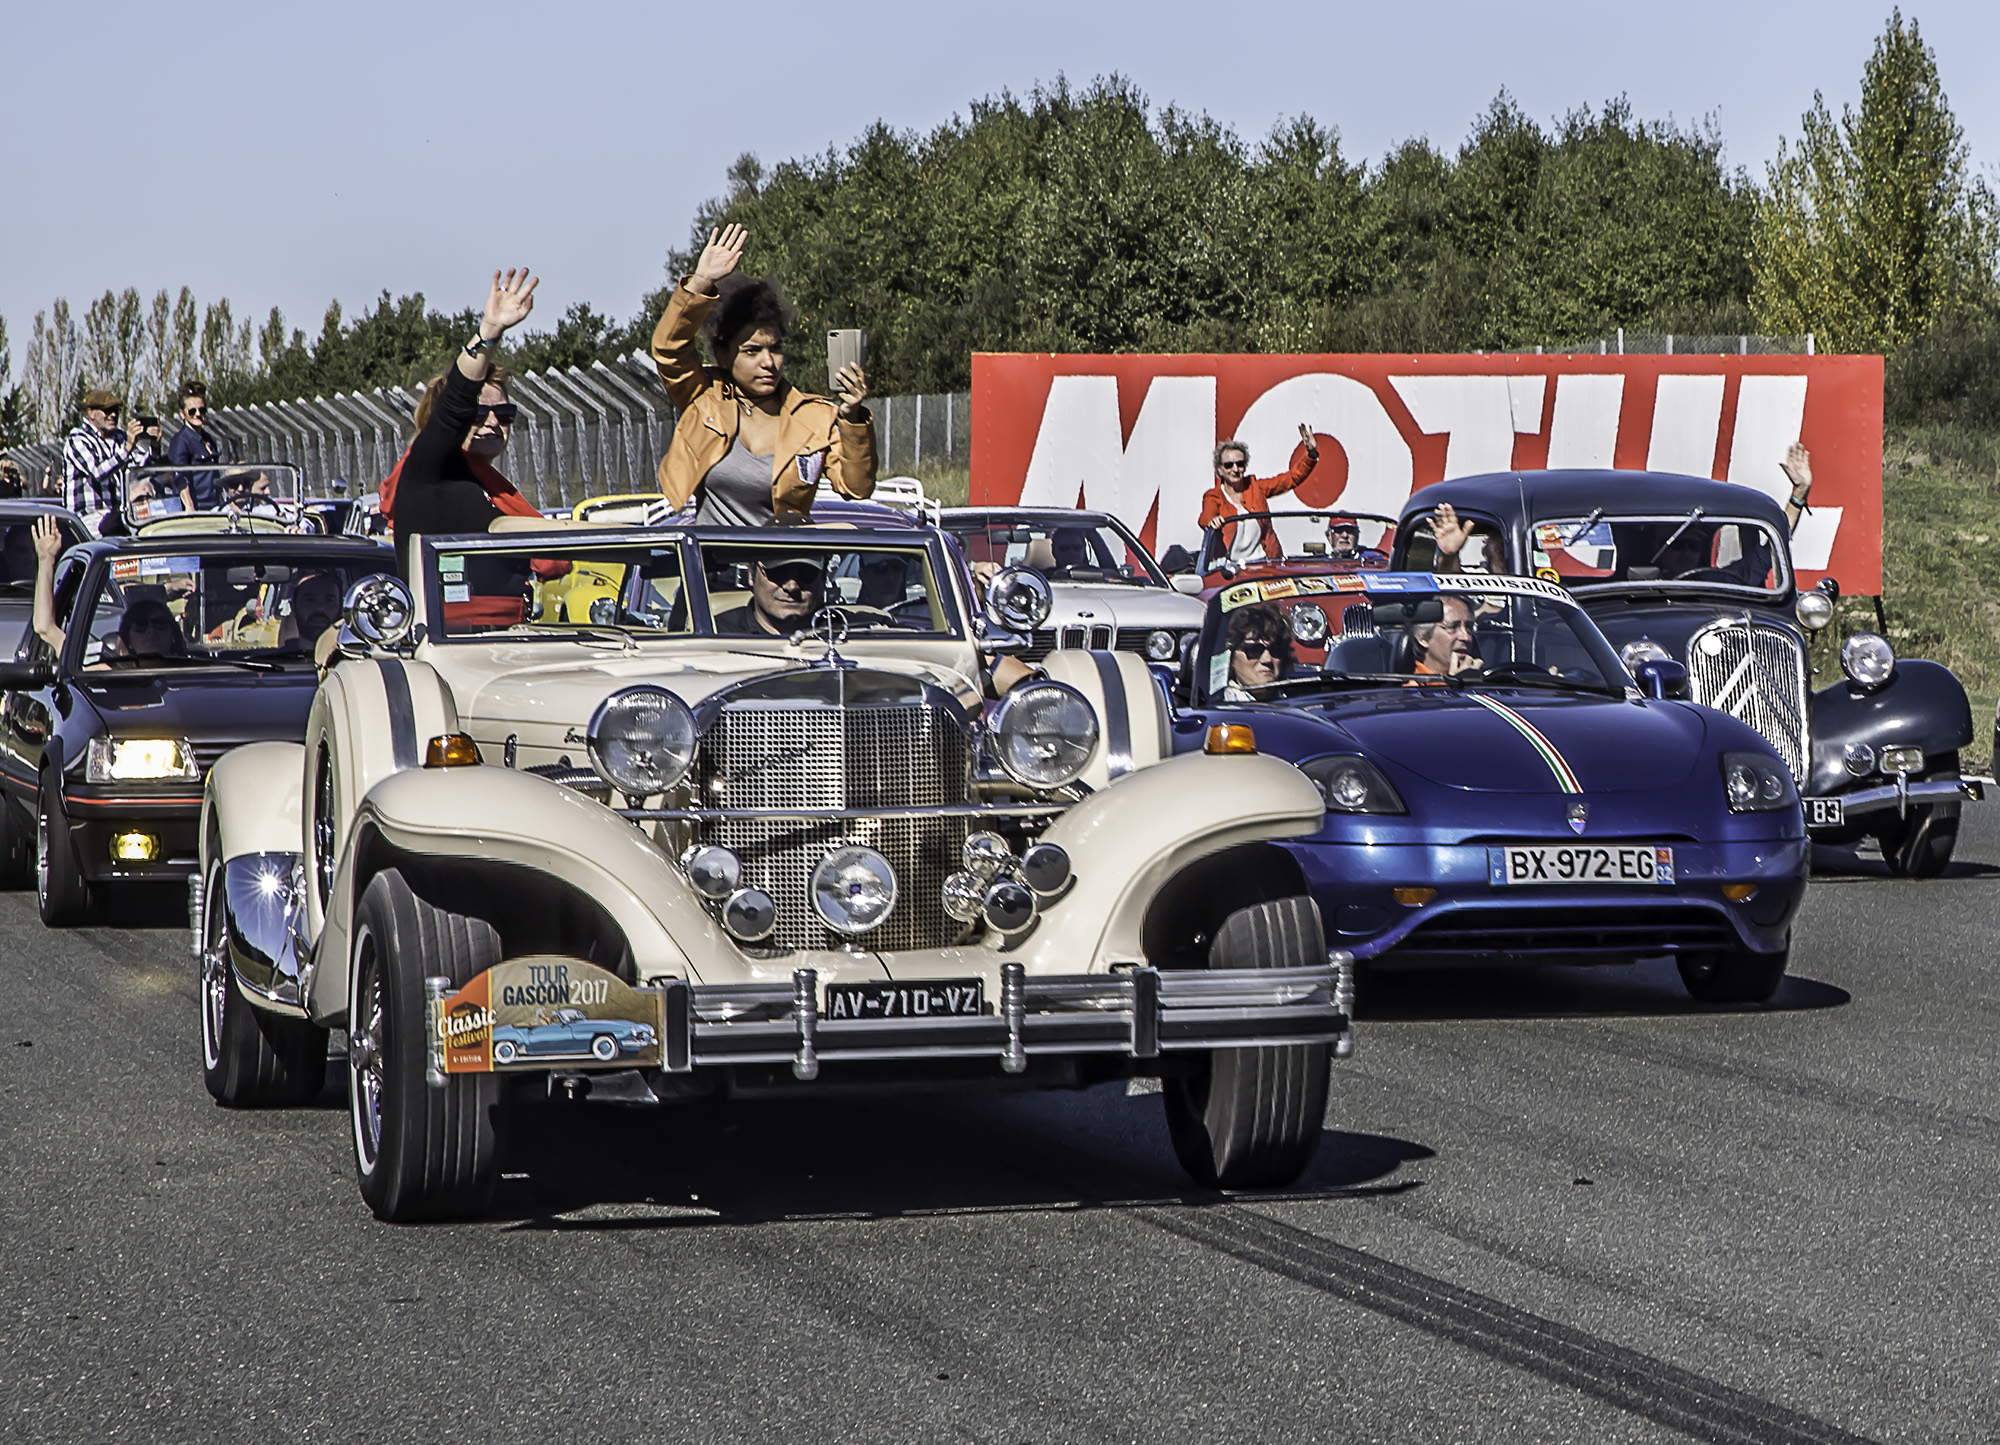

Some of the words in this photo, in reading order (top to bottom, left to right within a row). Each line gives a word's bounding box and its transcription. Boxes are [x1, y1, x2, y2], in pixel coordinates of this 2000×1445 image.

[1018, 373, 1843, 570] MOTUL
[1511, 849, 1654, 880] BX-972-EG
[528, 965, 568, 985] TOUR
[503, 985, 570, 1006] GASCON
[569, 979, 608, 1005] 2017
[833, 987, 977, 1018] AV-710-VZ
[438, 1006, 497, 1039] Classic
